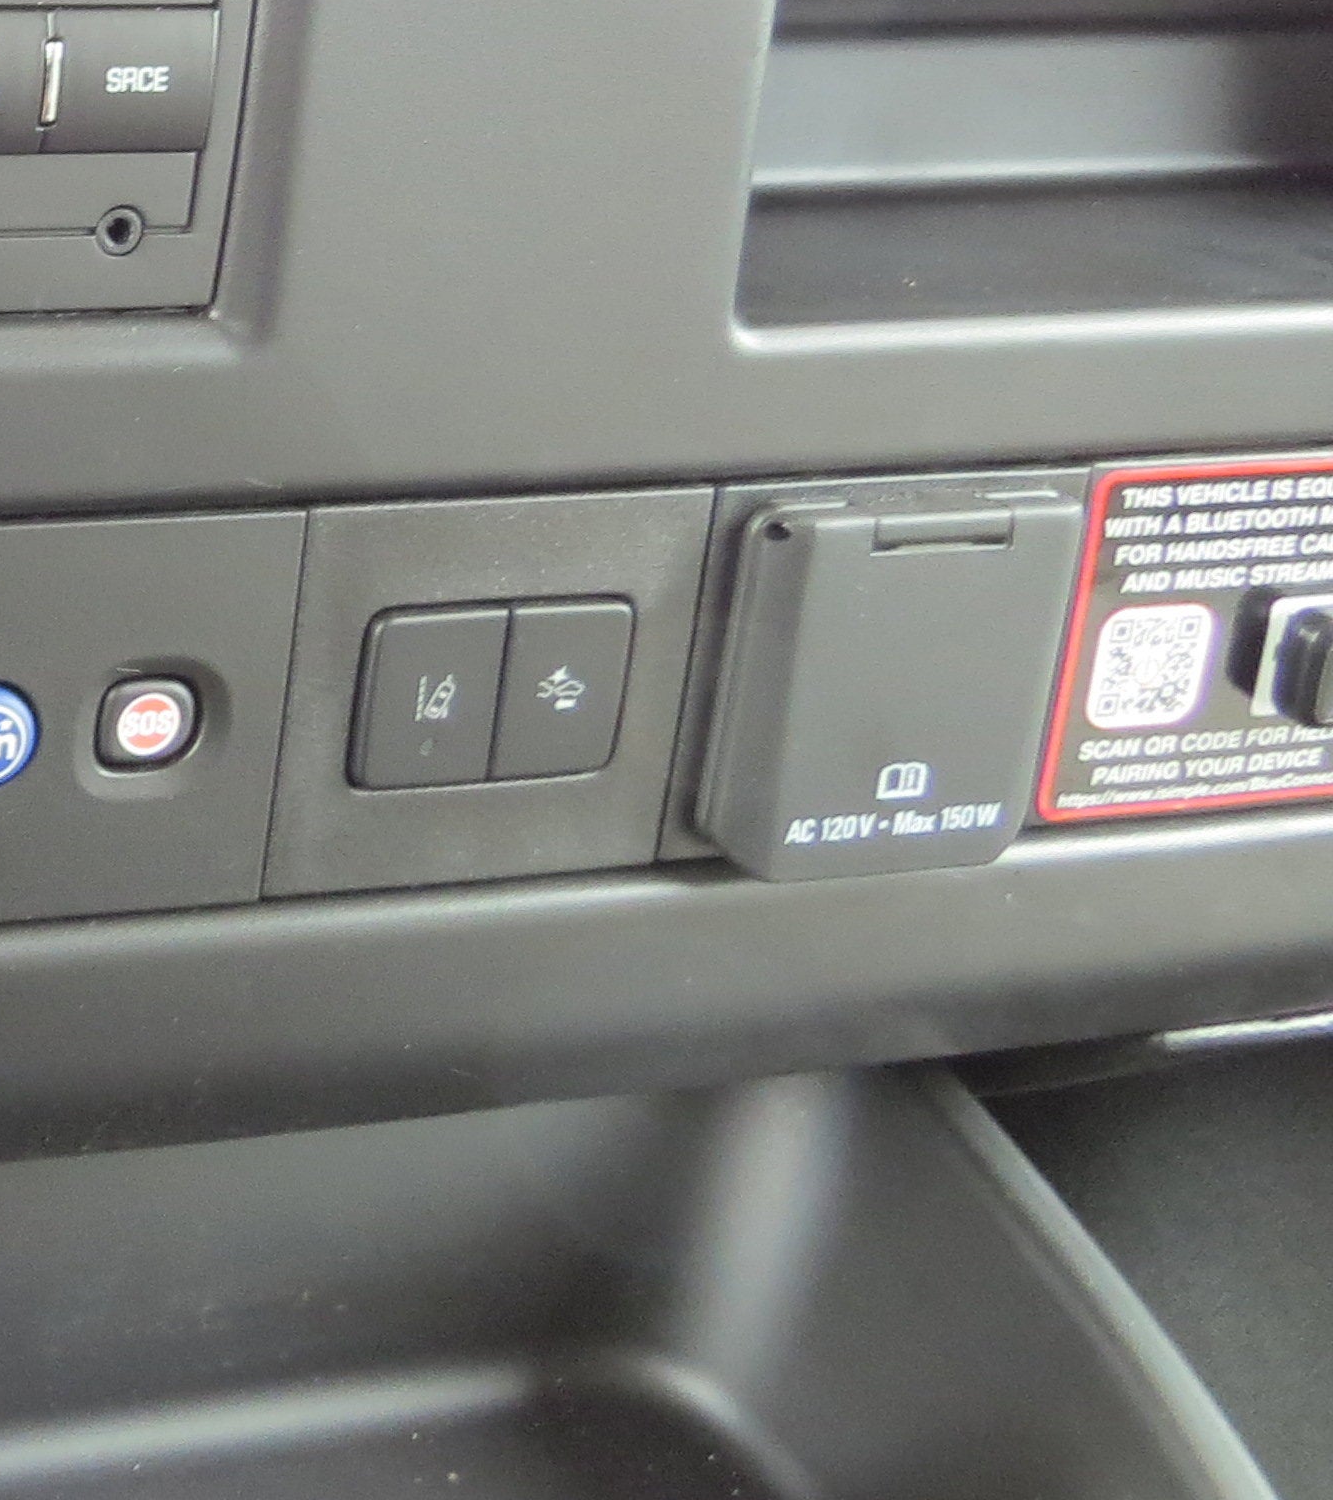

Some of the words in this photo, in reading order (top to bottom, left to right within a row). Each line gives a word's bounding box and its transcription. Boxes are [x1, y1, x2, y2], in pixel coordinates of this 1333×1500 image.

[105, 66, 170, 93] SRCE
[1121, 487, 1175, 509] THIS
[1177, 479, 1270, 506] VEHICLE
[1271, 479, 1294, 501] IS
[1104, 516, 1162, 538] WITH
[1163, 514, 1183, 535] A
[1186, 504, 1318, 535] BLUETOOTH
[1113, 545, 1161, 566] FOR
[1165, 534, 1299, 564] HANDSFREE
[1119, 571, 1170, 594] AND
[1173, 566, 1247, 591] MUSIC
[122, 710, 173, 737] SOS
[1078, 737, 1142, 761] SCAN
[1143, 734, 1178, 756] QR
[1180, 729, 1241, 753] CODE
[1243, 725, 1289, 748] FOR
[1090, 760, 1180, 787] PAIRING
[1182, 754, 1246, 779] YOUR
[1247, 746, 1325, 773] DEVICE
[784, 818, 816, 845] AC
[892, 809, 935, 835] Max
